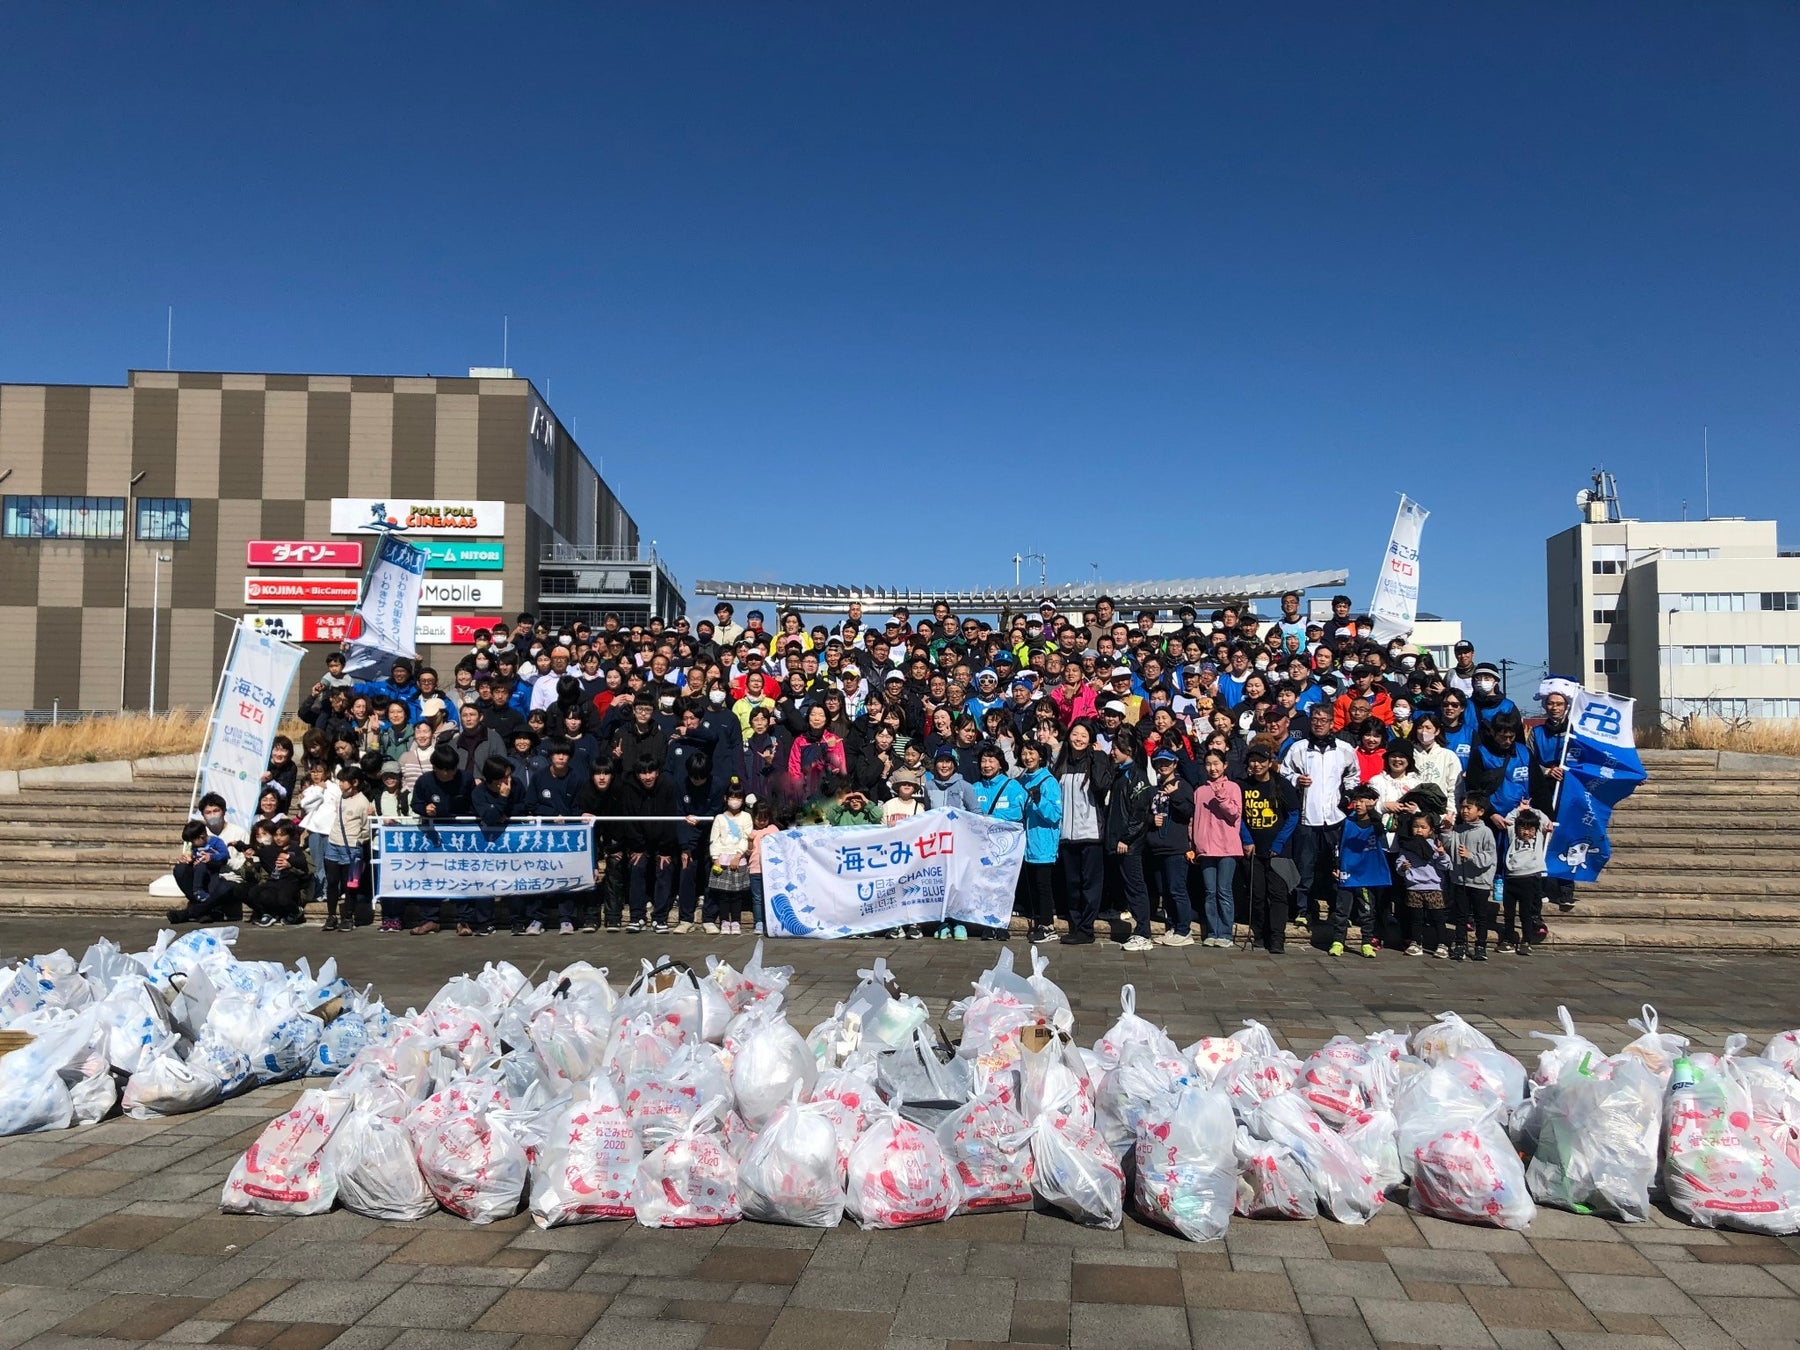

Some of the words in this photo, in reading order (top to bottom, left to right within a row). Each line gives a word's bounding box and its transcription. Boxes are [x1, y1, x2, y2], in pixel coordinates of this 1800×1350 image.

[410, 505, 440, 517] POLE
[443, 506, 474, 517] POLE
[405, 514, 478, 529] CINEMAS
[272, 543, 336, 562] ダイソー
[460, 551, 500, 561] NITORI
[262, 585, 304, 595] KOJIMA
[311, 587, 357, 596] BicCamera
[425, 585, 482, 601] Mobile
[265, 617, 284, 628] 中央
[232, 677, 276, 709] 海ごみ
[239, 701, 264, 725] ゼロ
[1245, 790, 1260, 798] NO
[835, 841, 913, 875] 海ごみ
[914, 831, 954, 860] ゼロ
[390, 857, 563, 873] ランナーは走るだけじゃない
[898, 866, 943, 885] CHANGE
[394, 875, 584, 892] いわきサンシャイン拾活クラブ
[875, 878, 895, 889] 日本
[922, 885, 945, 897] BLUE
[603, 1140, 626, 1150] 2020
[698, 1155, 719, 1167] 2020
